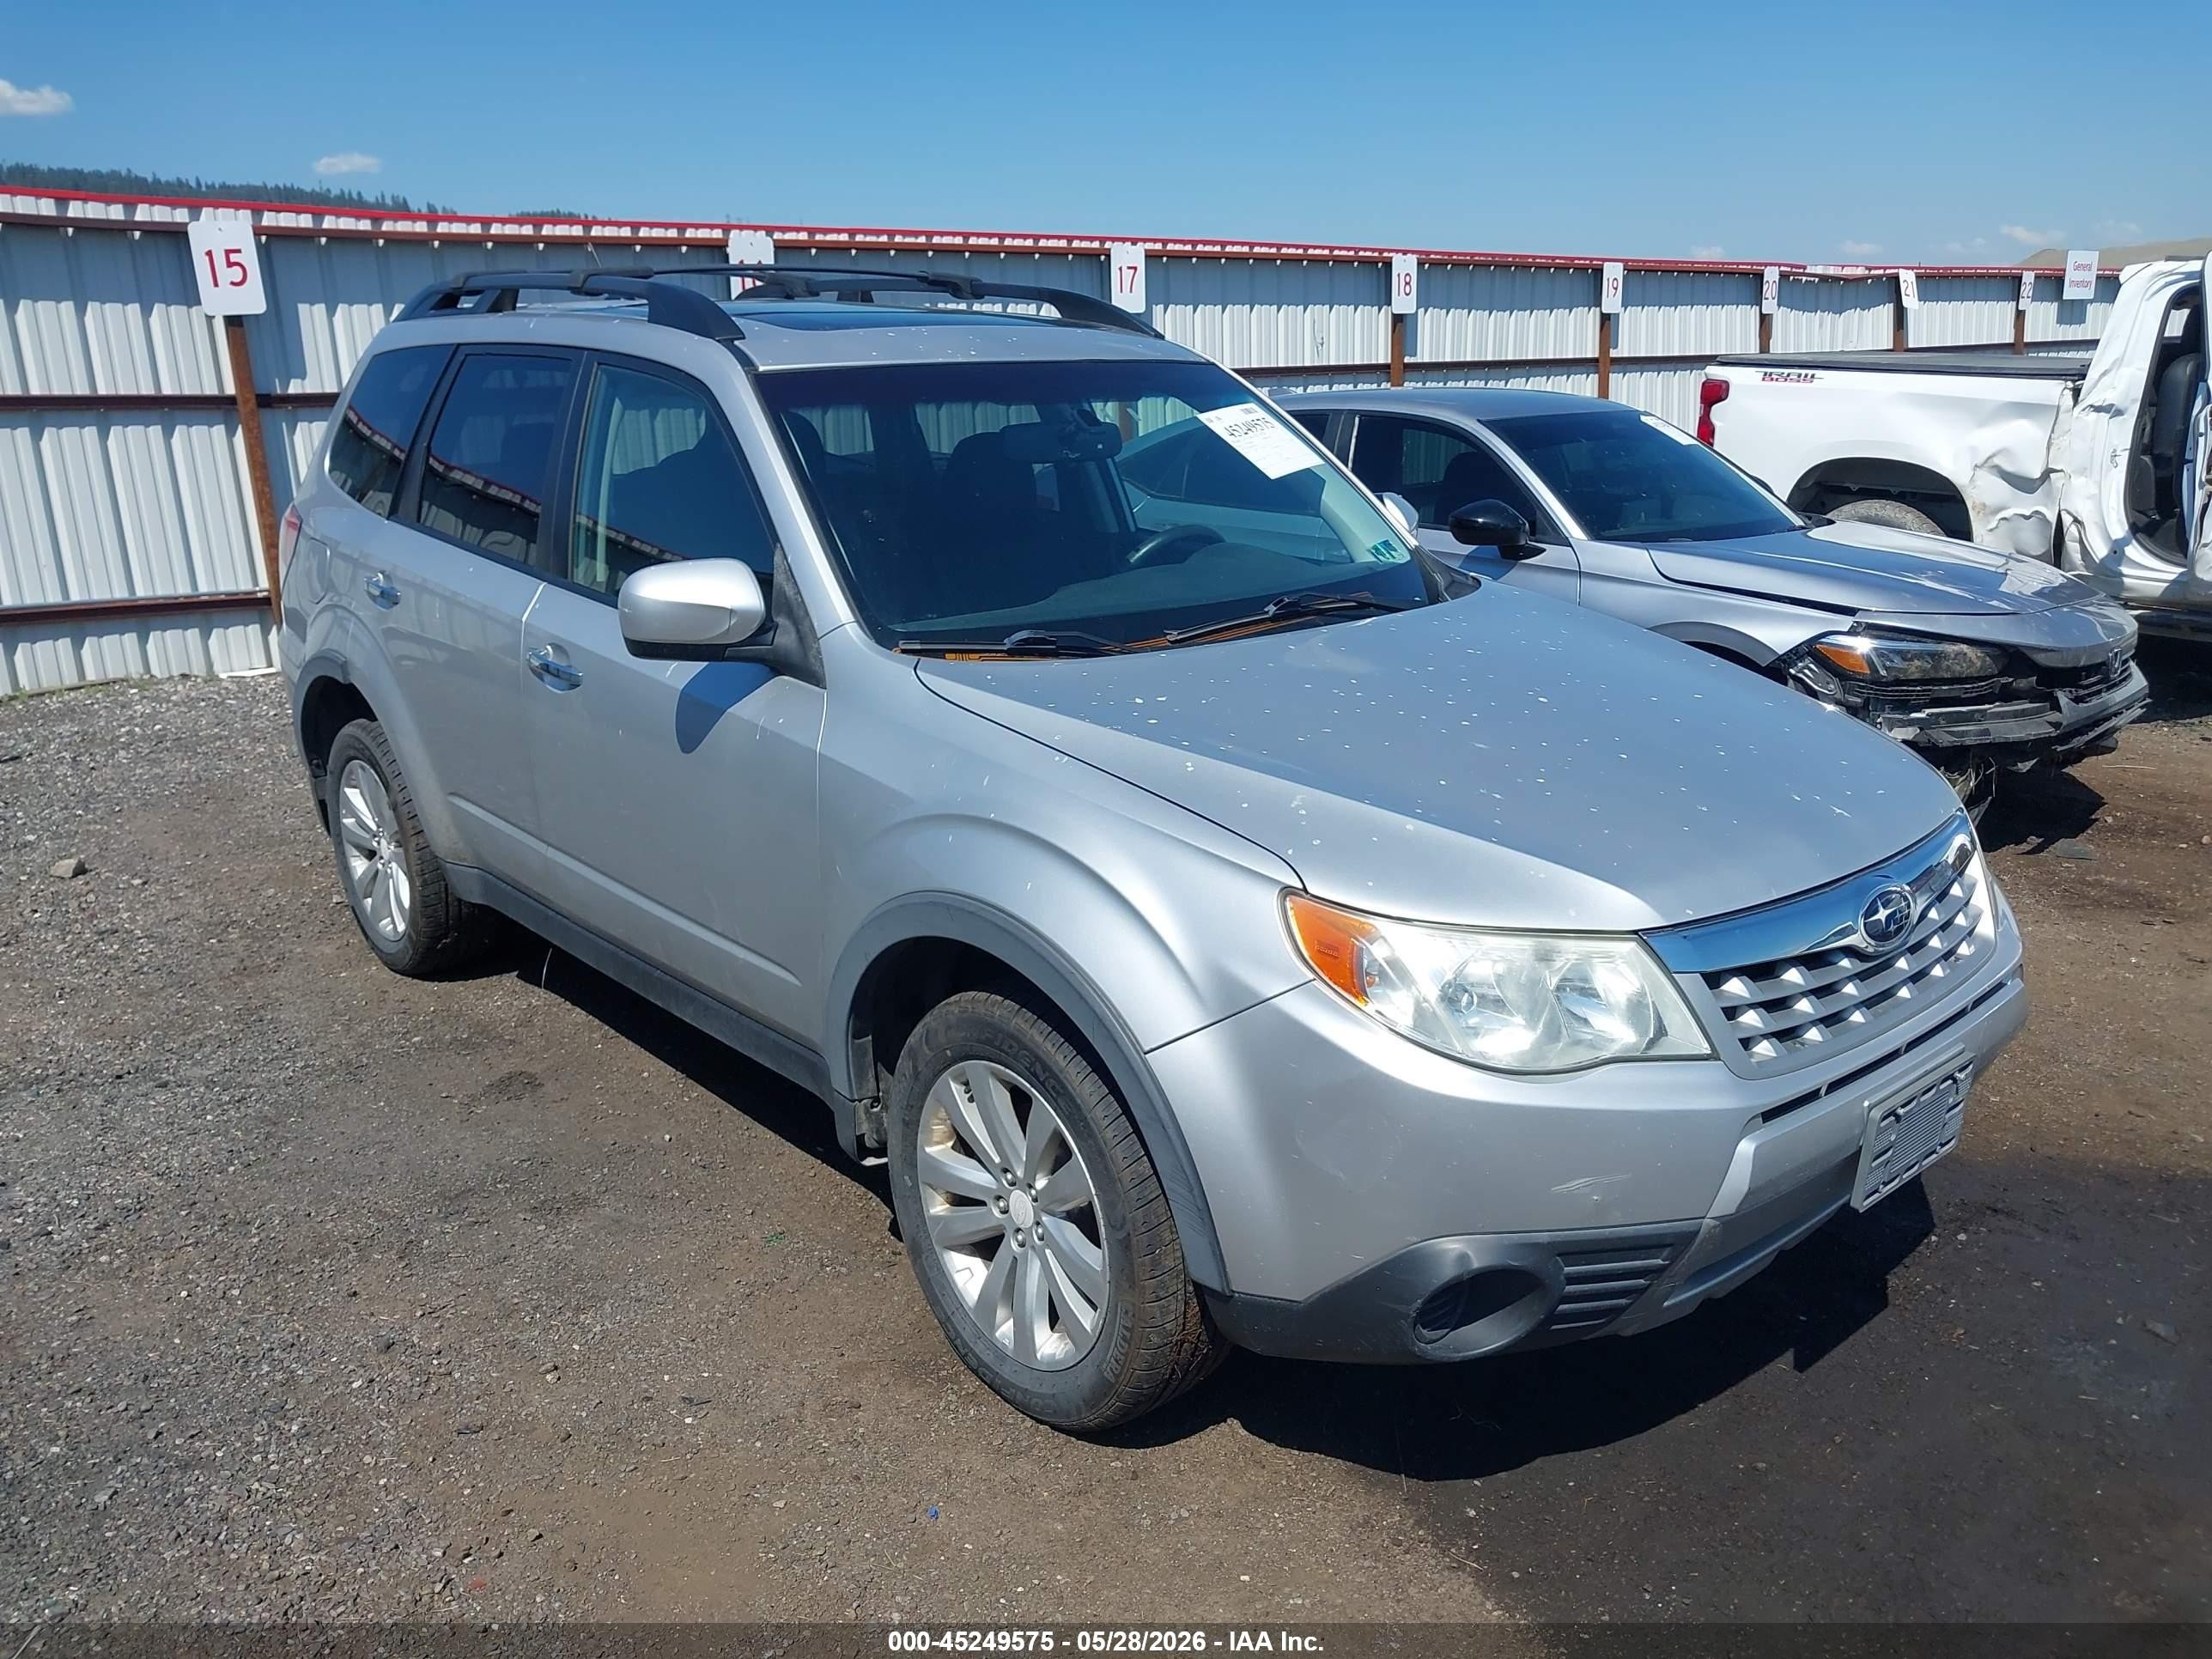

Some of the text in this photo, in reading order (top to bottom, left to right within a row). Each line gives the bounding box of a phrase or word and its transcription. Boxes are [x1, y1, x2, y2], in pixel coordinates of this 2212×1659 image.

[204, 249, 248, 288] 15
[2073, 261, 2093, 271] General
[1118, 265, 1138, 294] 17
[1397, 272, 1412, 296] 18
[1607, 276, 1619, 298] 19
[1903, 279, 1916, 298] 21
[2021, 281, 2033, 299] 22
[2069, 278, 2093, 290] Inventory
[1764, 280, 1777, 301] 20
[1754, 370, 1824, 380] TRAIL
[1224, 417, 1276, 438] 45249575
